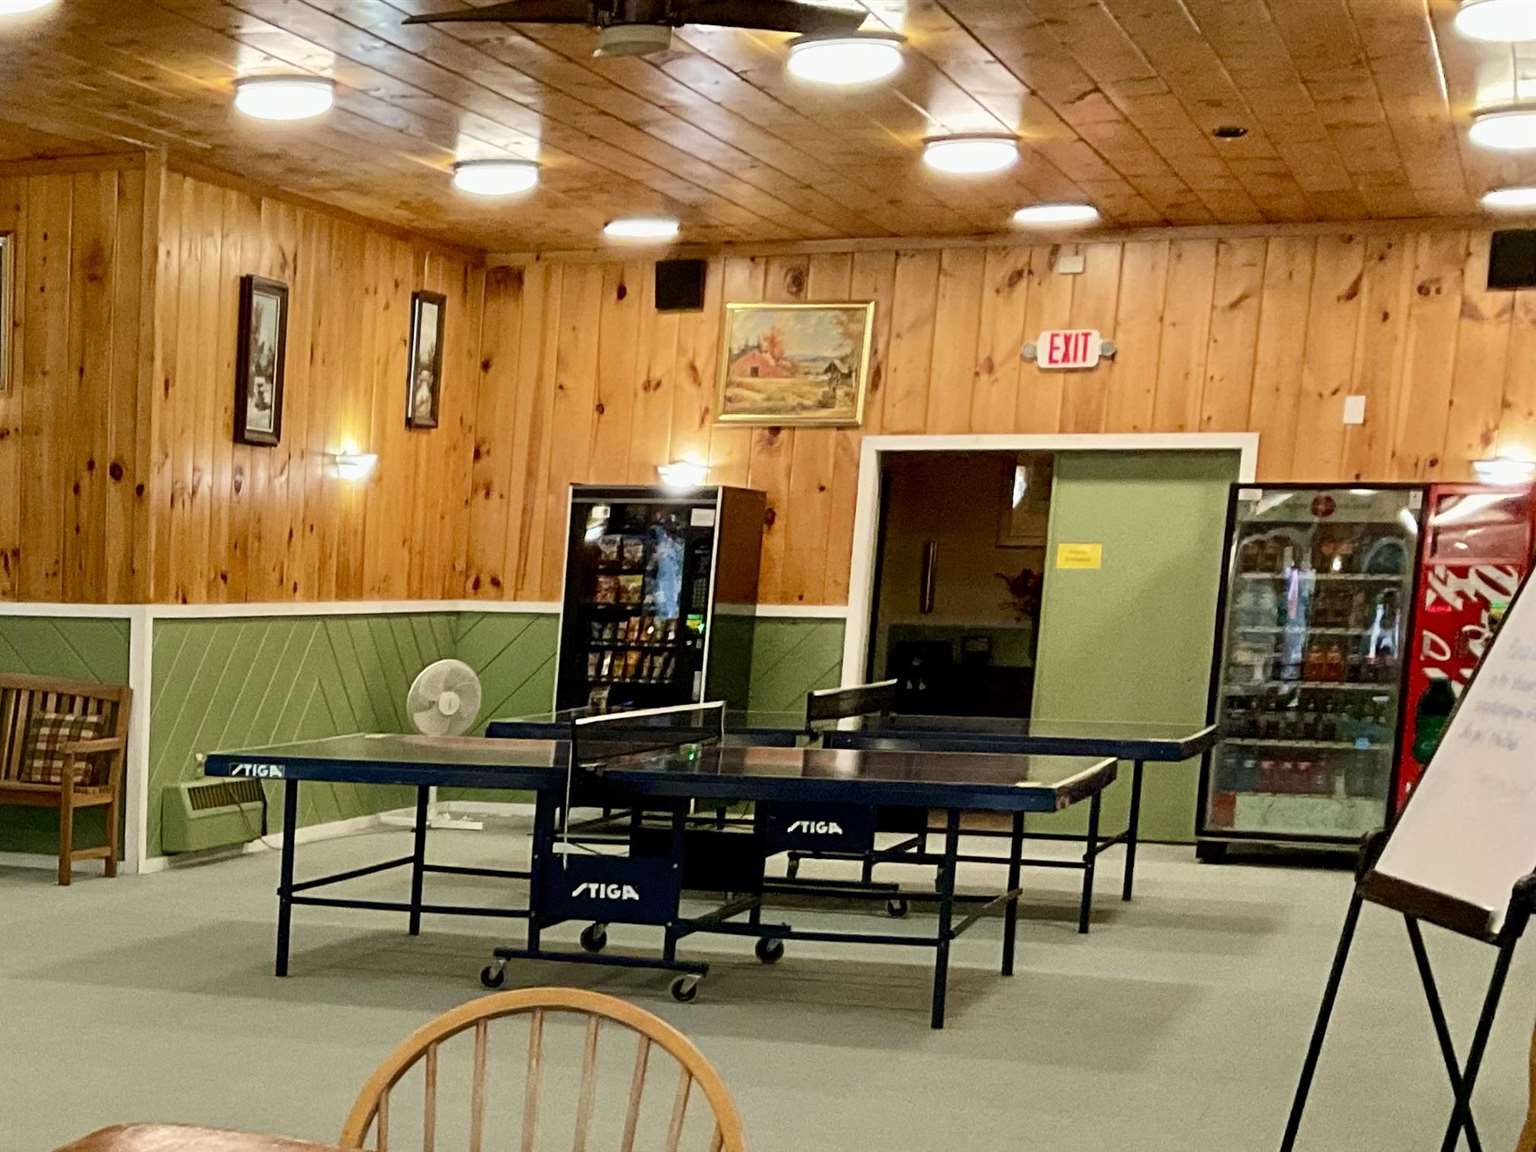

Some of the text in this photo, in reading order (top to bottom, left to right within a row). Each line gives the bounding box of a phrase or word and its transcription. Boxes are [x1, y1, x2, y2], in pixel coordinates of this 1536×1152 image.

[1048, 332, 1092, 364] EXIT
[231, 763, 282, 778] STIGA
[786, 820, 844, 835] STIGA
[571, 882, 640, 901] STIGA
